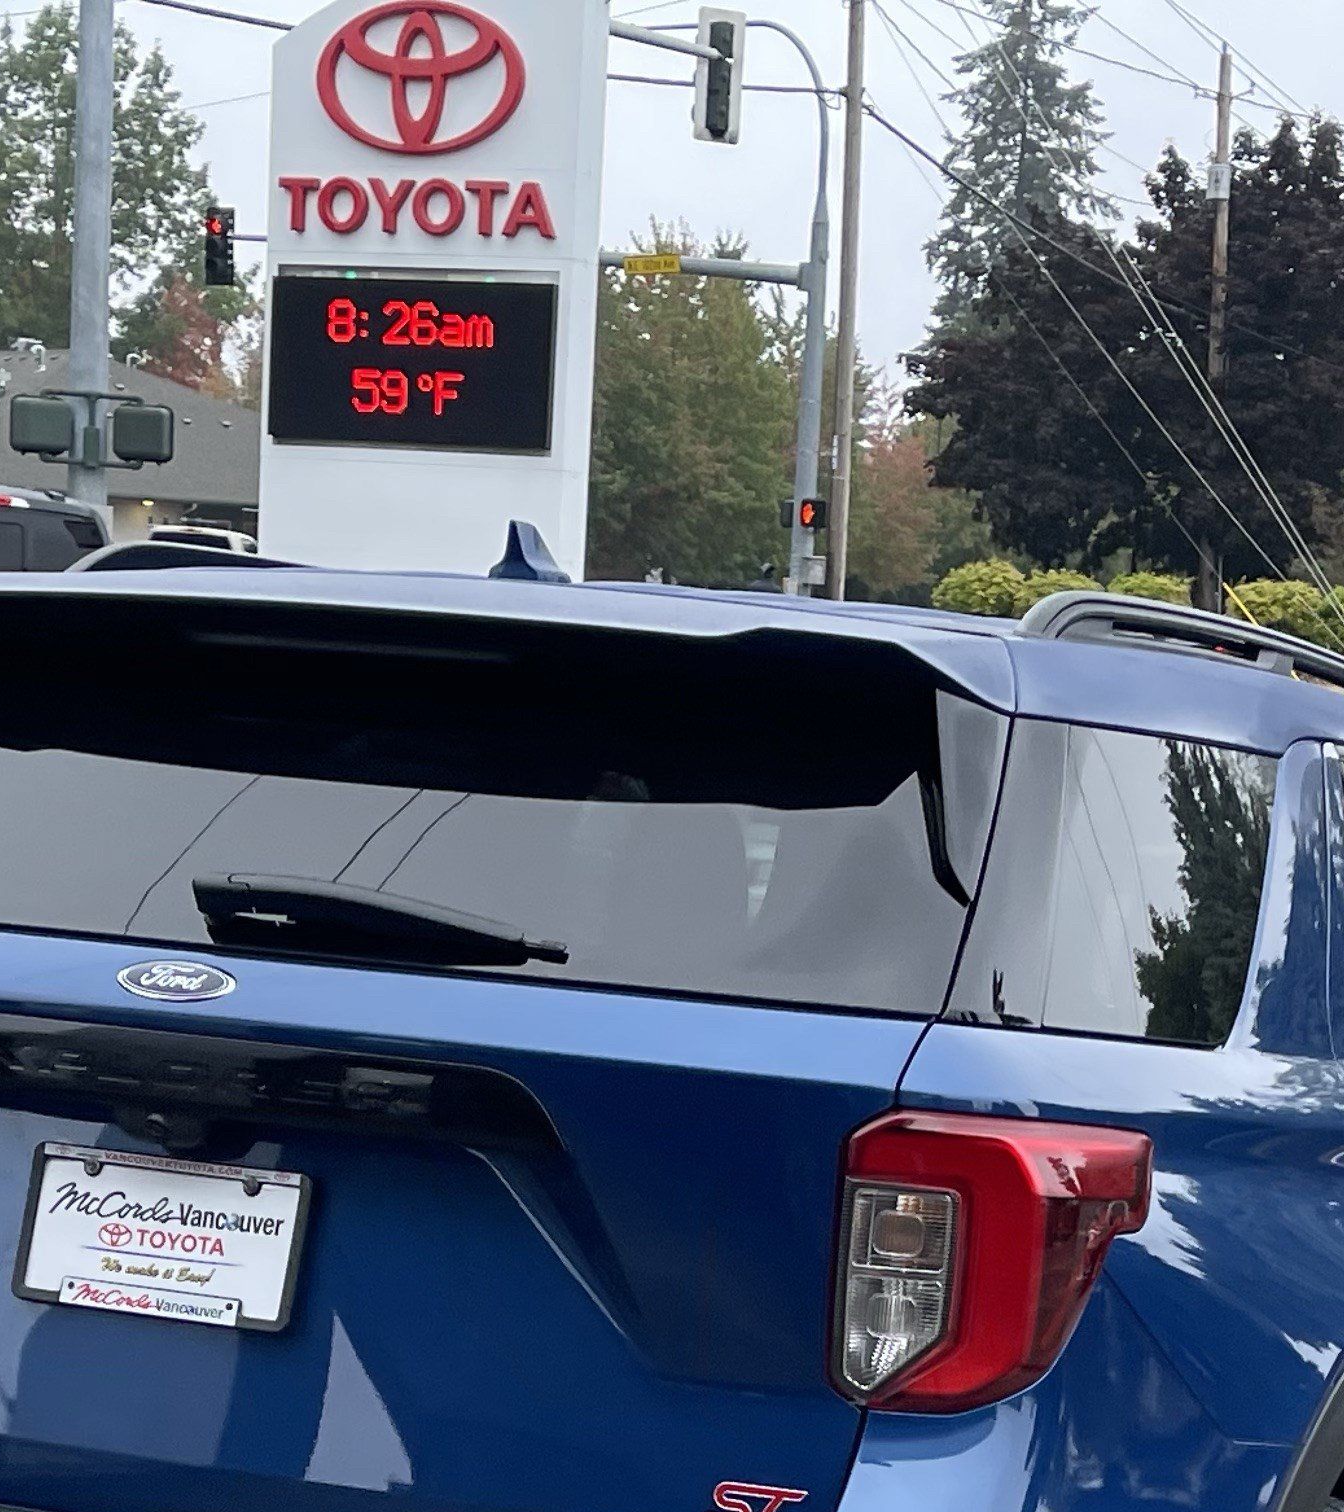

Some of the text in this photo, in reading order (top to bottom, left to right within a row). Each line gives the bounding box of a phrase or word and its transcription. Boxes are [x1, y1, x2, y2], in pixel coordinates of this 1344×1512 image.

[278, 176, 556, 240] TOYOTA
[327, 298, 495, 349] 8:26am
[140, 964, 208, 991] Ford
[137, 1228, 225, 1257] TOYOTA
